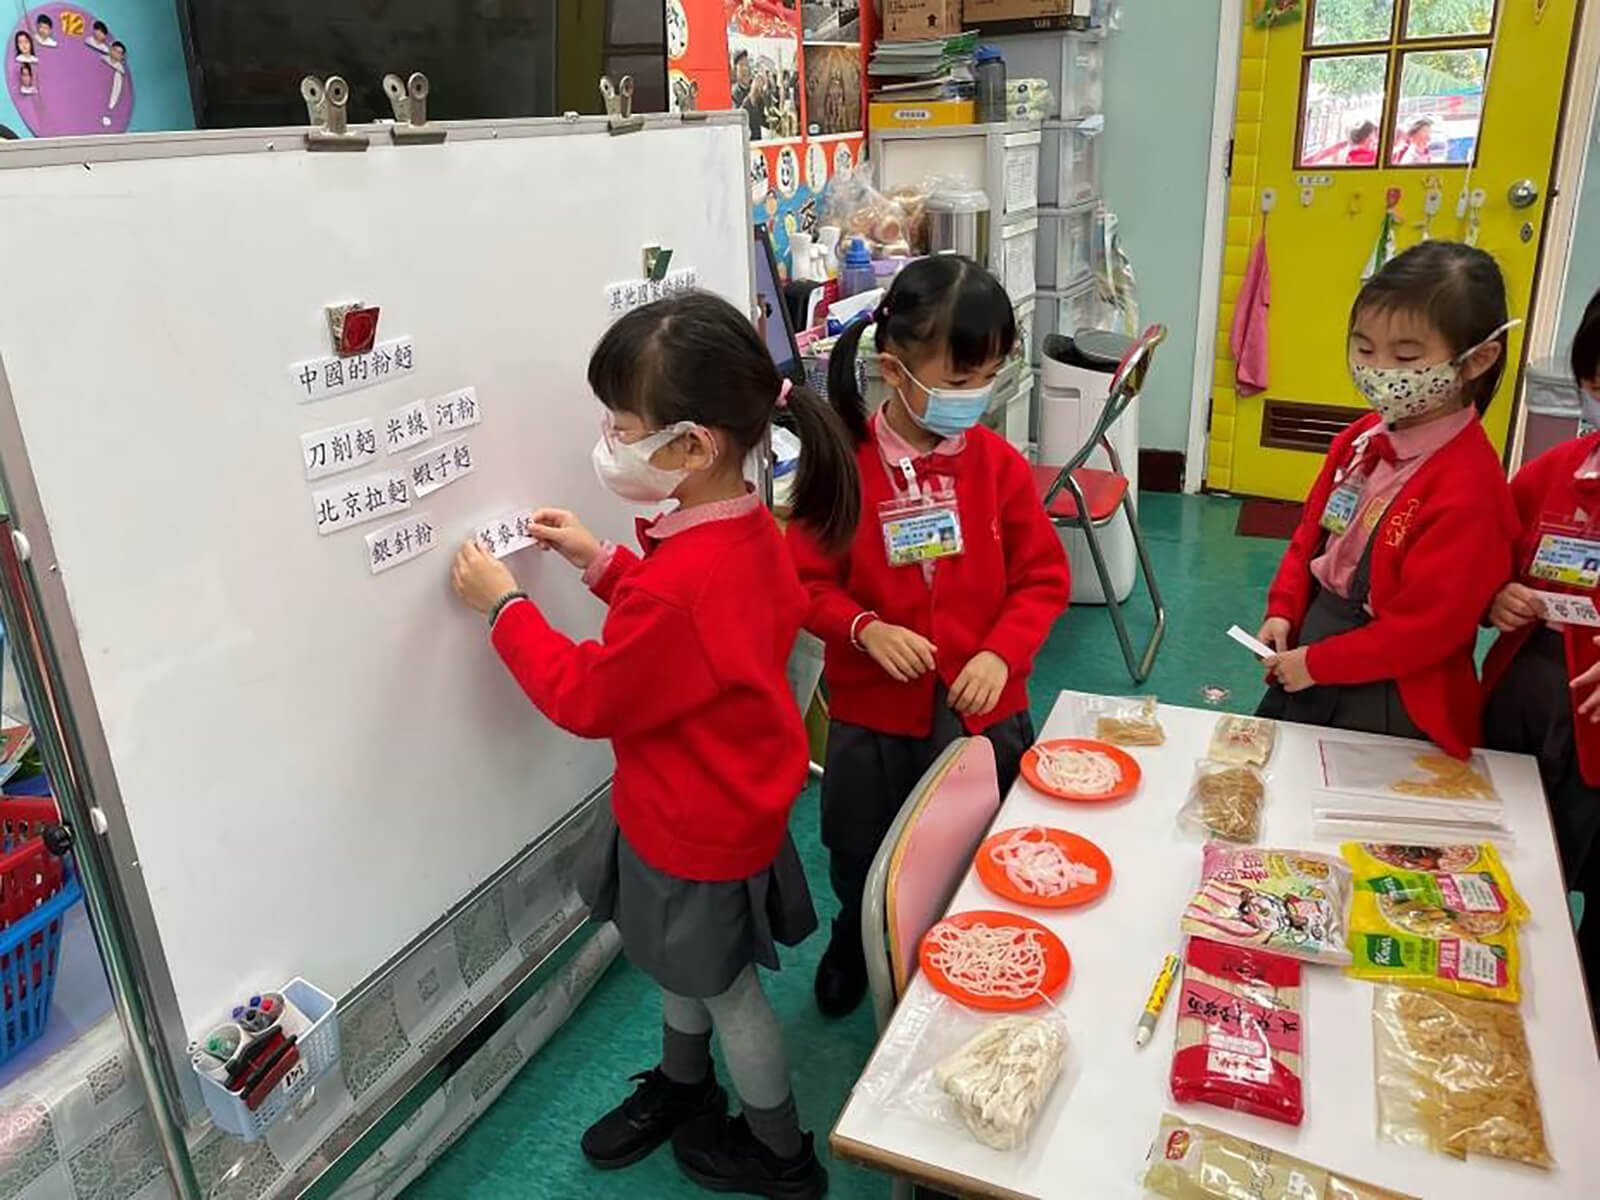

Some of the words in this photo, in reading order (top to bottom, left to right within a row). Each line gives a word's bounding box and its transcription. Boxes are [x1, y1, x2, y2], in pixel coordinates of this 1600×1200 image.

[62, 13, 84, 36] 12
[386, 409, 429, 444] 米線
[436, 396, 475, 426] 河粉
[372, 521, 433, 564] 銀針粉
